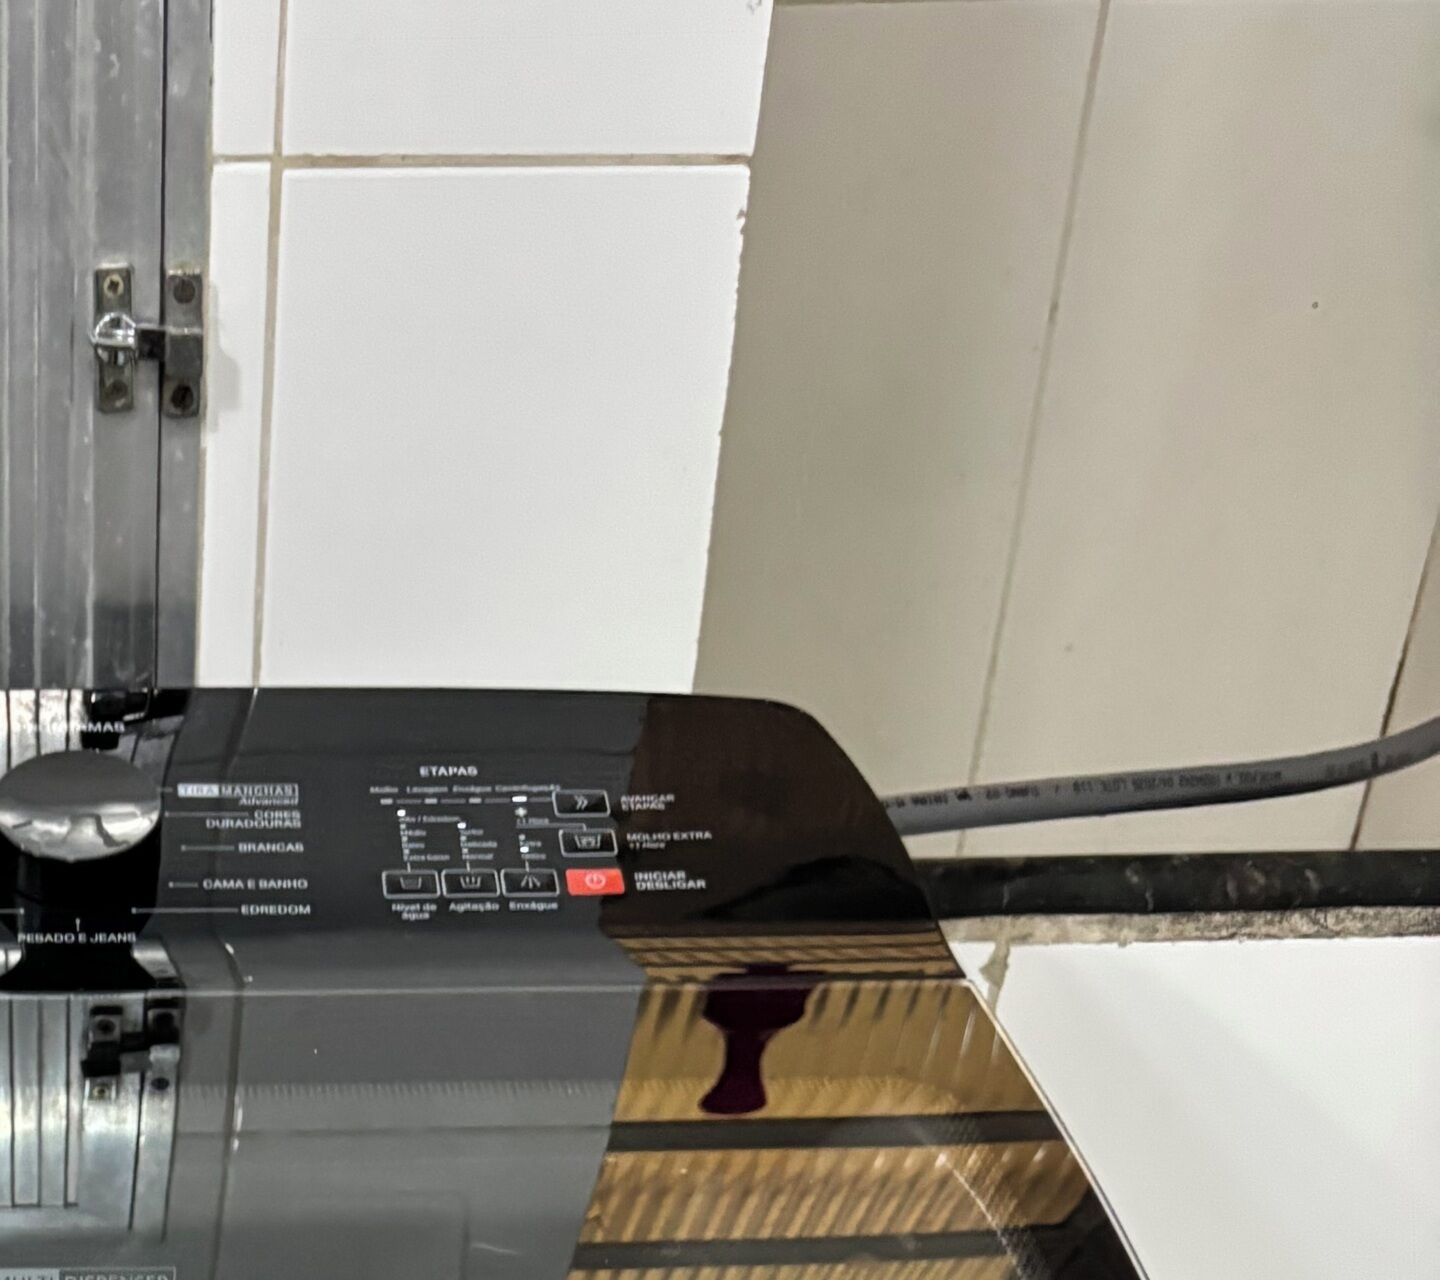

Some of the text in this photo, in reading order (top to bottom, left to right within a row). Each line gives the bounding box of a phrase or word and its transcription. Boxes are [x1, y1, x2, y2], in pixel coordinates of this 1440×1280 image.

[419, 765, 478, 777] ETAPAS
[221, 784, 294, 797] MANCHAS
[621, 802, 665, 811] ETAPAS
[254, 809, 301, 820] CORES
[206, 818, 301, 829] DURADOURAS
[626, 831, 712, 842] MOLHO EXTRA
[238, 842, 304, 853] BRANCAS
[634, 870, 686, 881] INICIAR
[202, 878, 308, 890] CAMA E BANHO
[636, 879, 706, 891] DESLIGAR
[240, 904, 311, 915] EDREDOM
[17, 932, 137, 944] PESADO E JEANS
